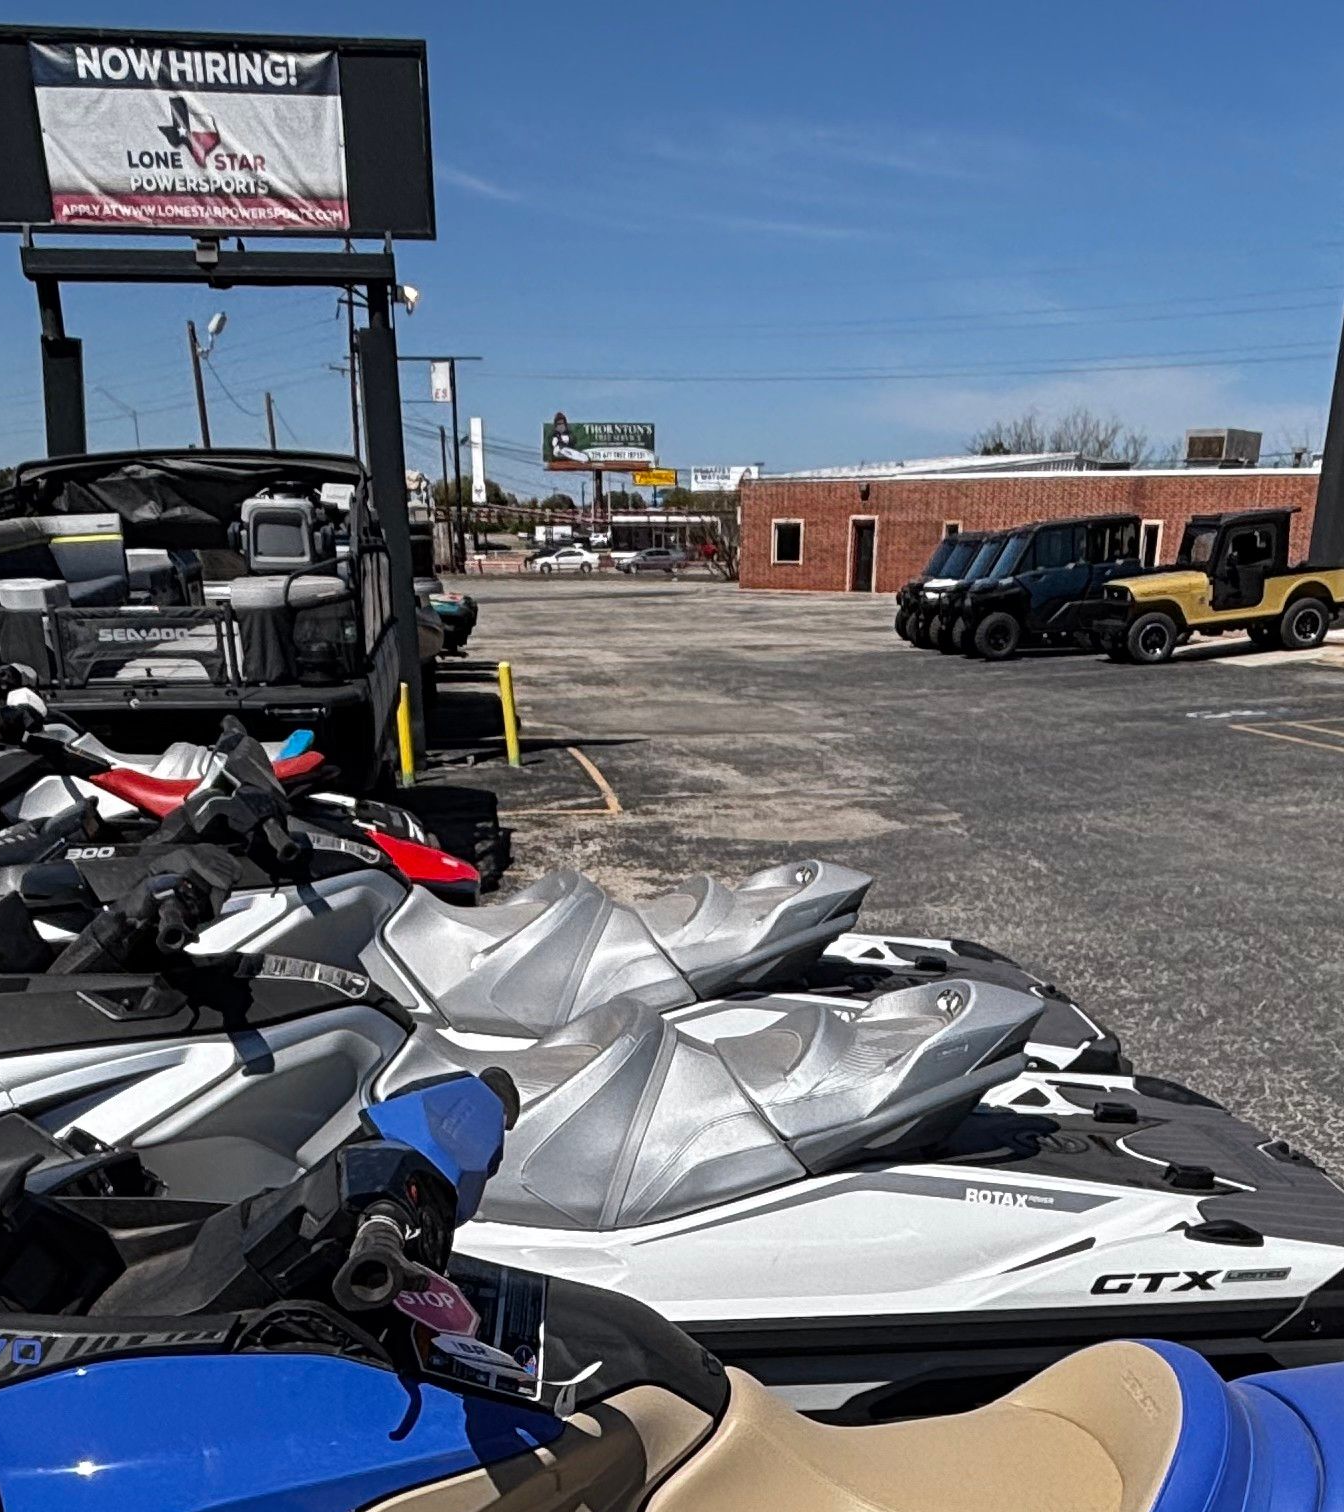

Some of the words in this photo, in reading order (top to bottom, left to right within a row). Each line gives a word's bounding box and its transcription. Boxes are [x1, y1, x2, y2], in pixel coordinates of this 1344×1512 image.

[75, 46, 160, 80] NOW
[169, 48, 298, 86] HIRING!
[127, 151, 183, 170] LONE
[214, 153, 266, 172] STAR
[130, 175, 270, 195] POWERSPORTS
[62, 204, 99, 217] APPLY
[102, 204, 117, 216] AT
[65, 847, 116, 860] 300
[965, 1187, 1028, 1208] ROTAX
[1090, 1269, 1223, 1295] GTX
[1227, 1269, 1288, 1281] LIMITED
[399, 1291, 456, 1310] STOP
